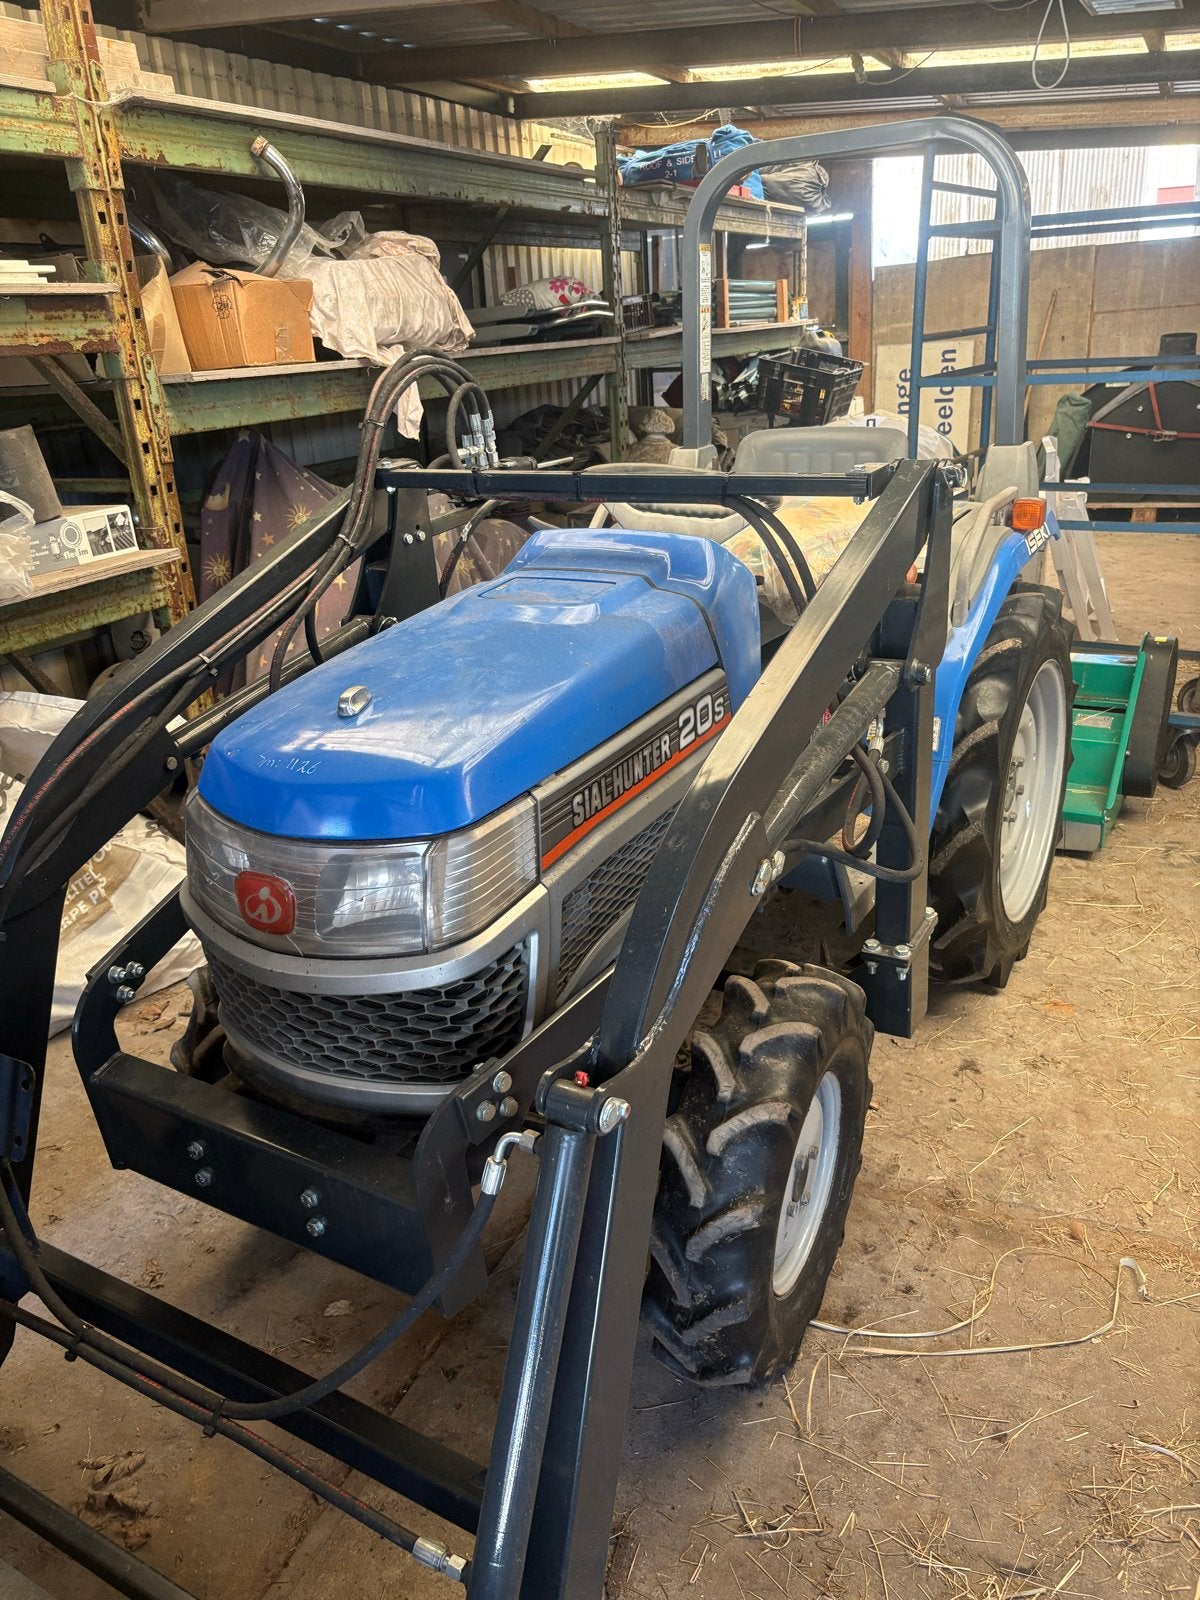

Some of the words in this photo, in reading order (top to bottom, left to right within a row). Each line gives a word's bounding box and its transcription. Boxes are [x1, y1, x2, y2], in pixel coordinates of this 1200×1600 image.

[639, 159, 663, 171] ROOF
[666, 158, 673, 168] &
[664, 169, 677, 179] 2-1
[1024, 521, 1051, 556] ISEKI
